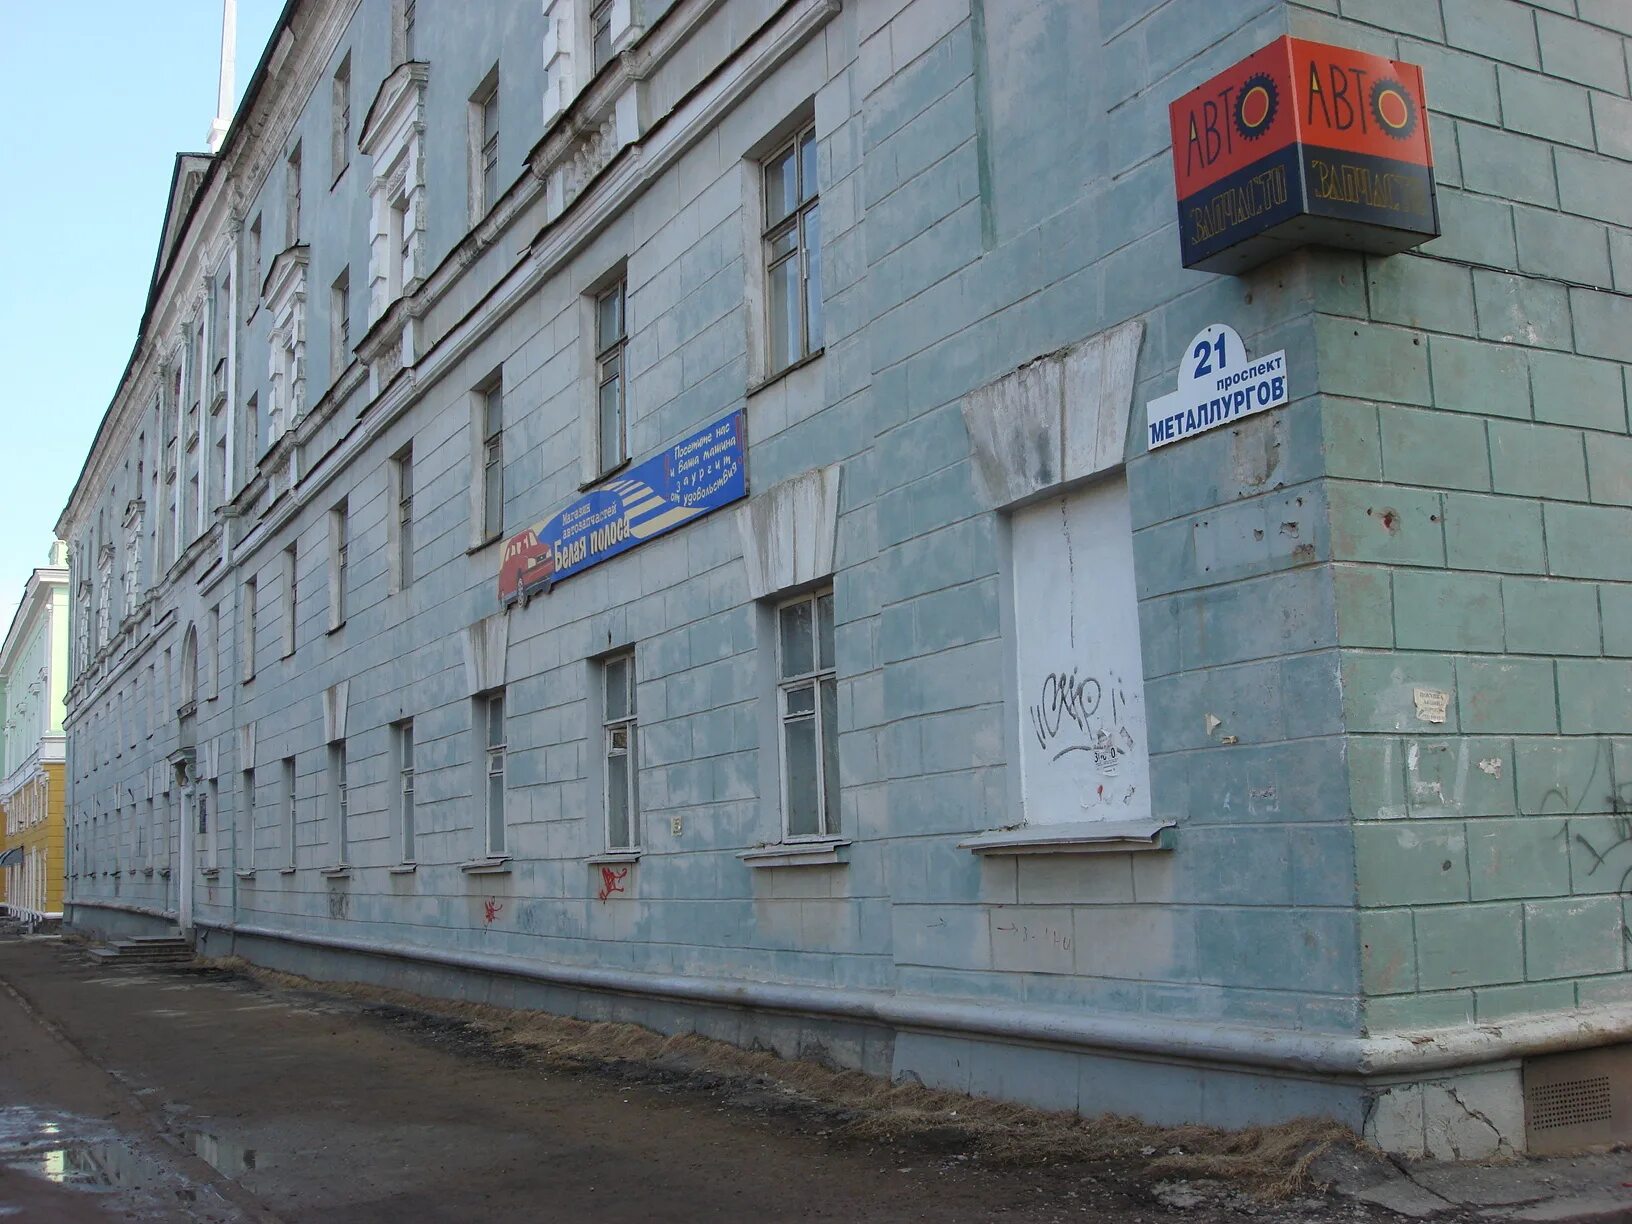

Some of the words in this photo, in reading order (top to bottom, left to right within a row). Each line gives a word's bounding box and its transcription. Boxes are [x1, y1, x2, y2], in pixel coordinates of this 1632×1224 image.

[1193, 332, 1227, 380] 21
[1216, 356, 1282, 392] проспект
[1150, 376, 1285, 445] МЕТАЛЛУРГОВ
[670, 467, 675, 477] и
[678, 455, 700, 474] Ваша
[703, 436, 737, 461] машина
[674, 433, 712, 460] Посетите
[716, 423, 730, 438] нас
[670, 493, 680, 503] от
[683, 461, 737, 507] удовольствия
[562, 502, 591, 526] Магазин
[562, 501, 617, 540] автозапчастей
[554, 535, 586, 572] Белая
[590, 516, 630, 555] полоса
